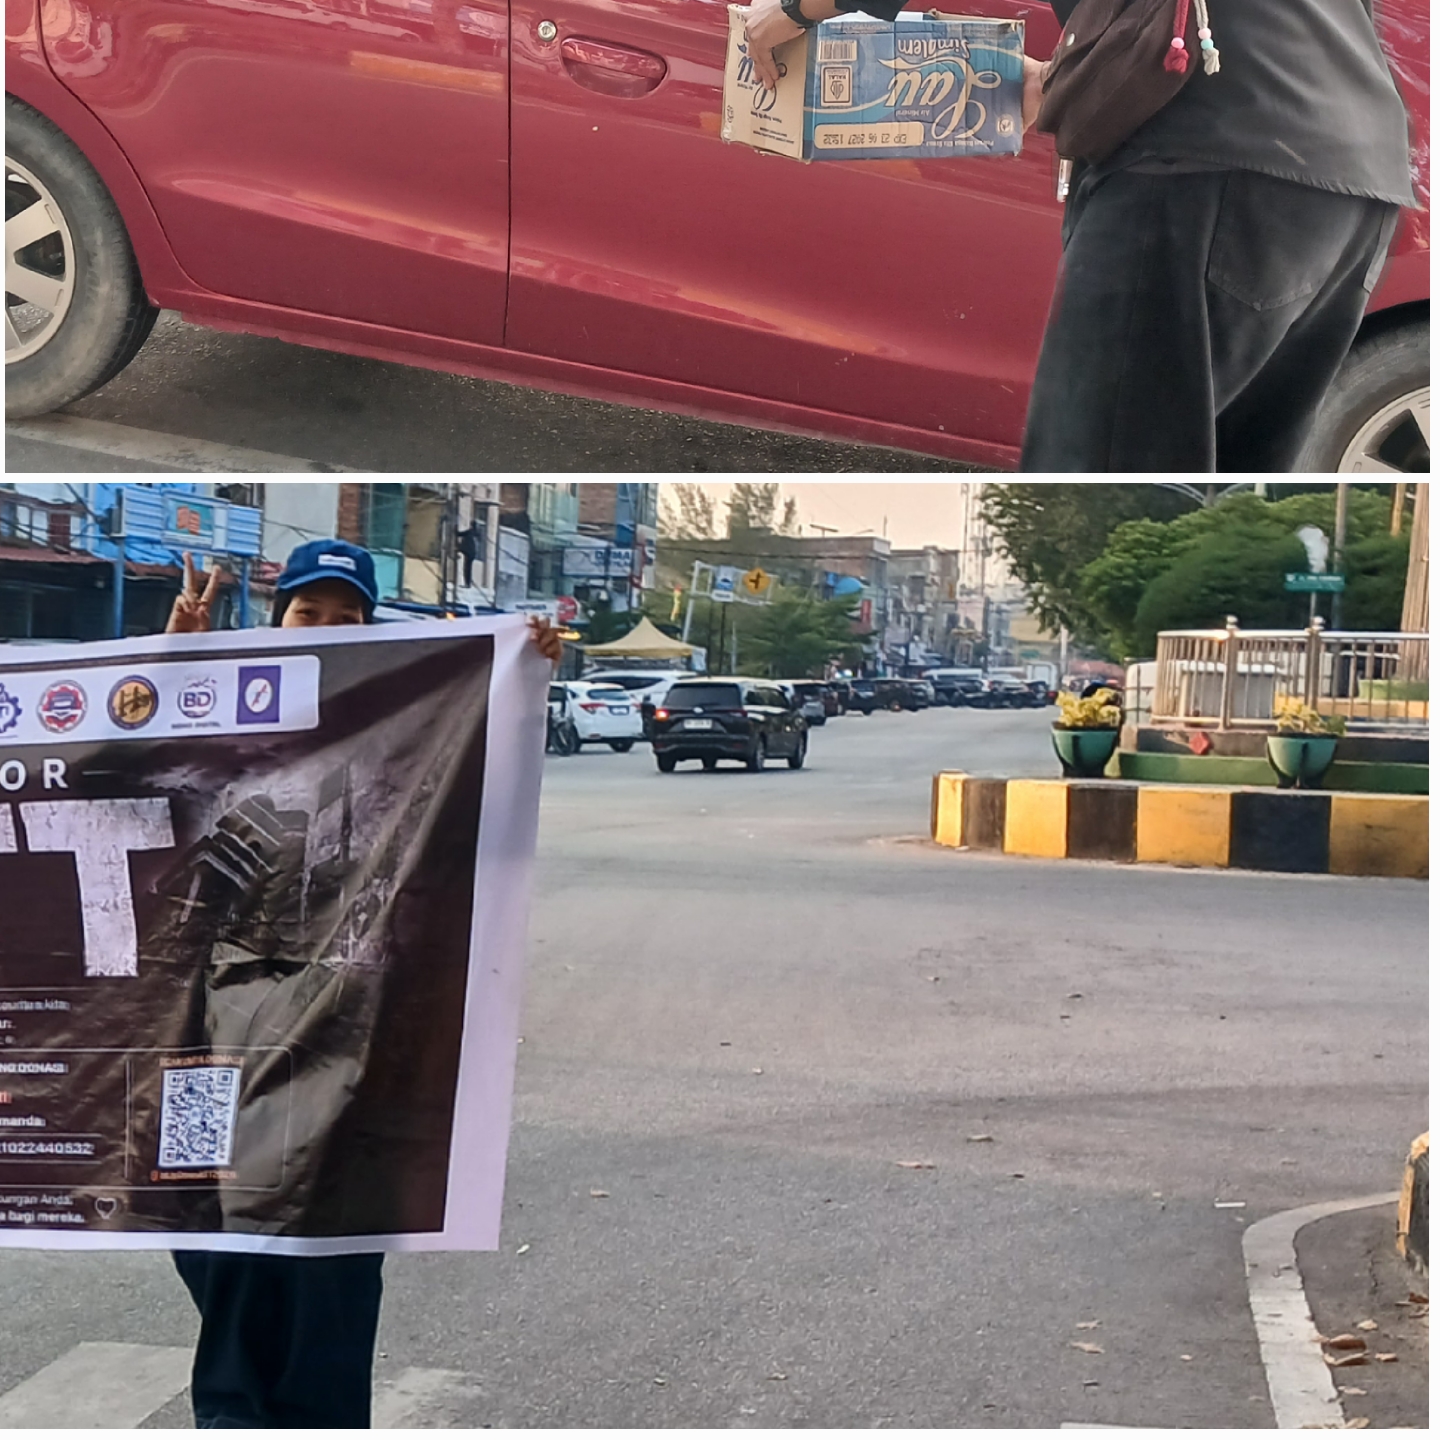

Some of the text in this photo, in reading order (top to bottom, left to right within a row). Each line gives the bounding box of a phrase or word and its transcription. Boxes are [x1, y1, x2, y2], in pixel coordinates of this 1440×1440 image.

[879, 57, 1002, 140] Lau
[896, 109, 930, 117] Air Mineral
[183, 691, 212, 708] BD
